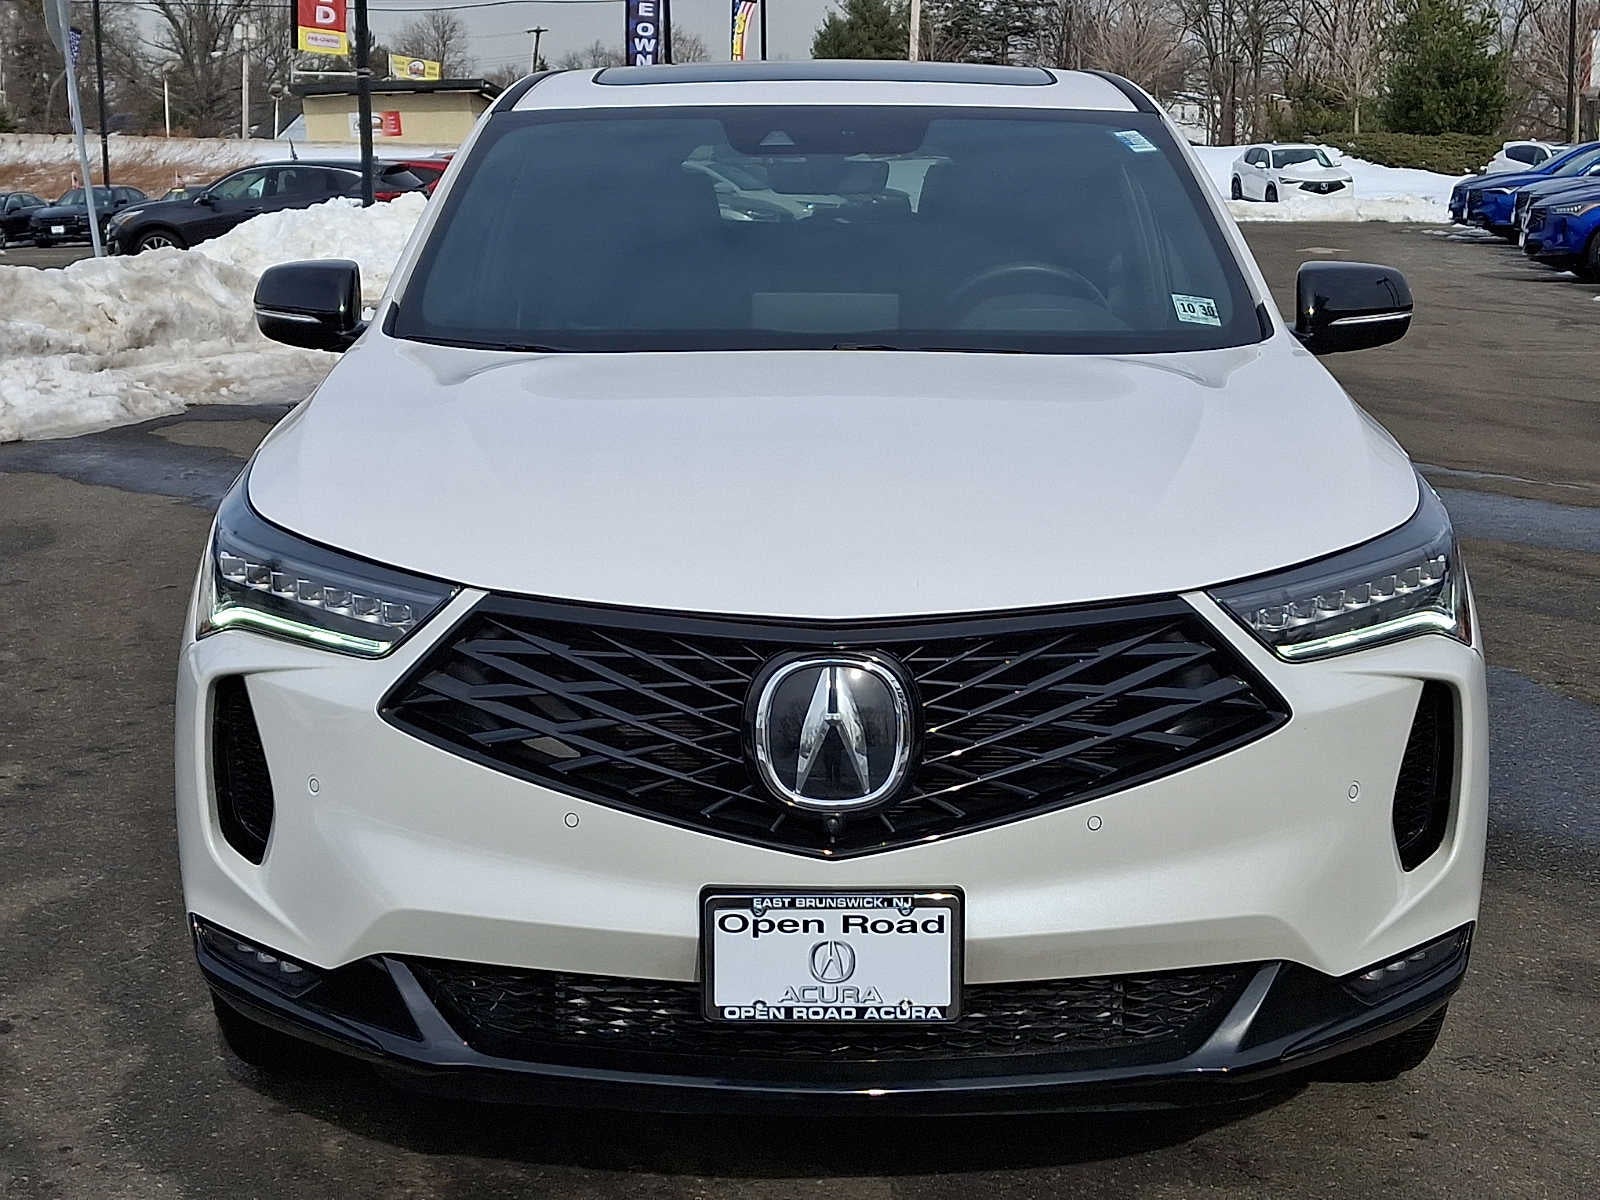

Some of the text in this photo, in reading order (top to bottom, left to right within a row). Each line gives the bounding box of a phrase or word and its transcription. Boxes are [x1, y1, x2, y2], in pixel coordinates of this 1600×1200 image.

[315, 0, 337, 24] D
[1180, 302, 1196, 314] 10
[752, 898, 791, 909] EAST
[892, 897, 912, 909] NJ
[718, 913, 946, 939] Open Road
[777, 985, 884, 1004] ACURA
[723, 1006, 944, 1020] OPEN ROAD ACURA
